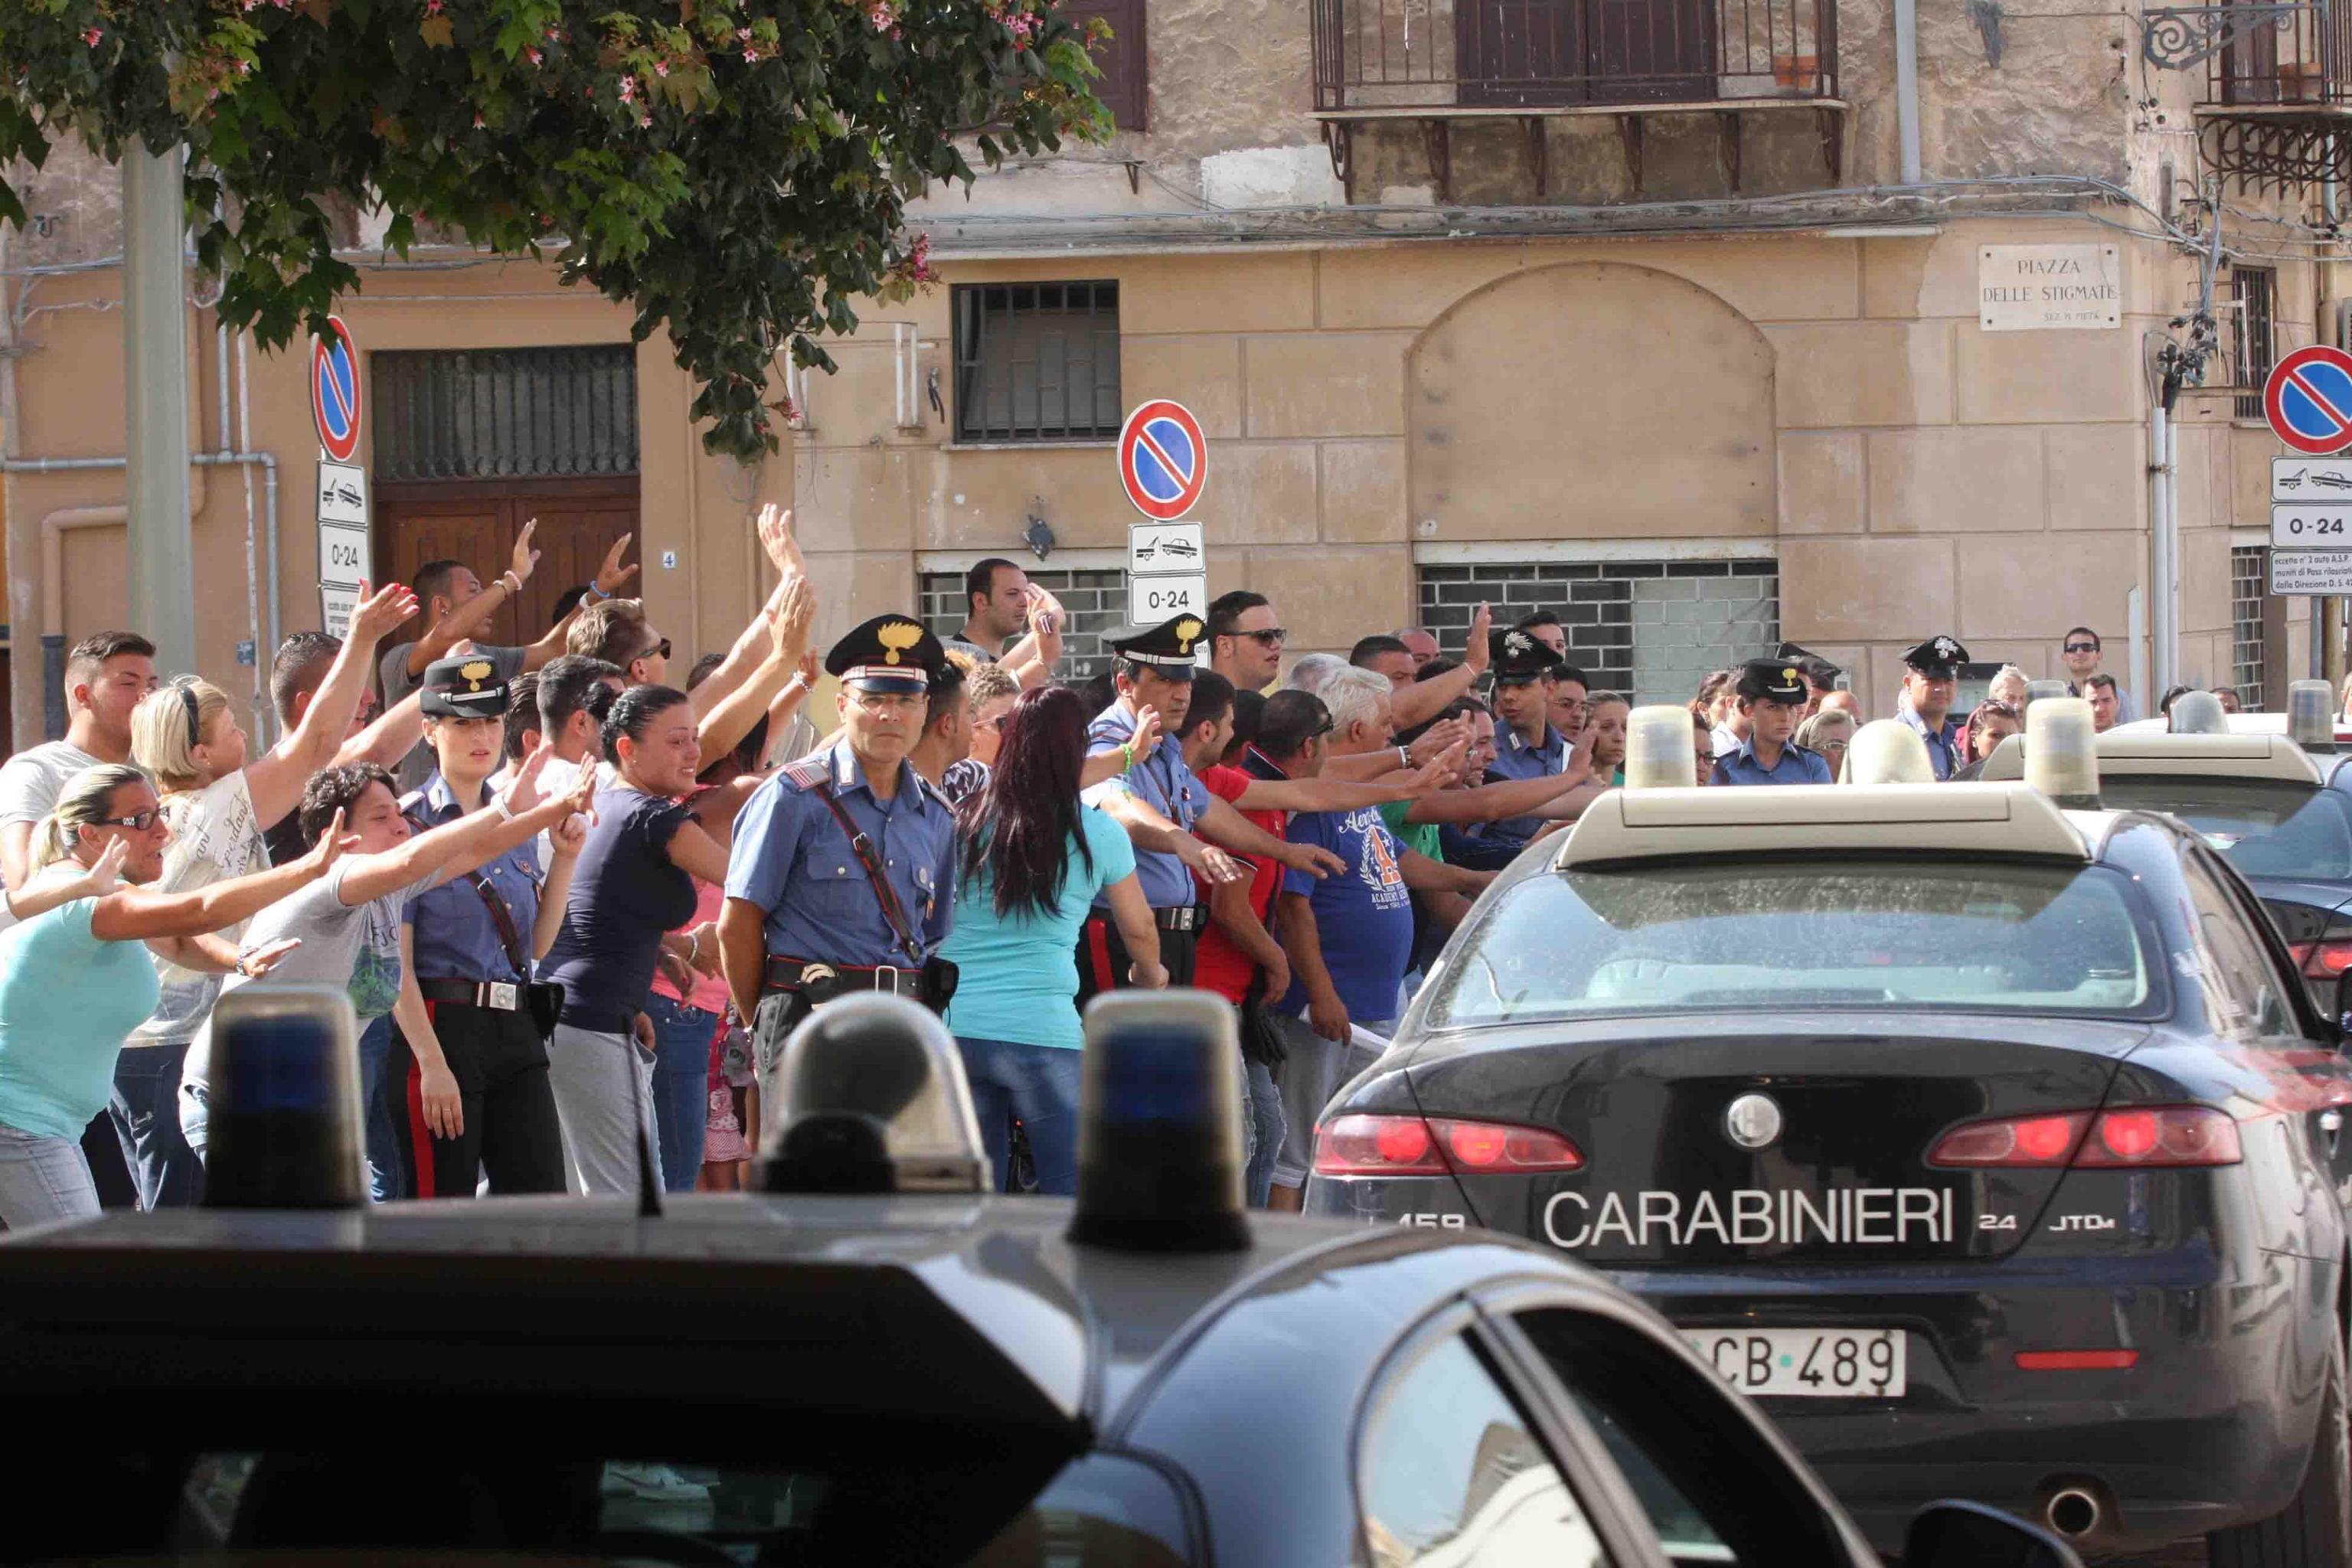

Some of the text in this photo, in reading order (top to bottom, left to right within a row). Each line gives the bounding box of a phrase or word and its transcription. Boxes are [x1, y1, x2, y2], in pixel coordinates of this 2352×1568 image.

[2018, 259, 2081, 274] PIAZZA
[1984, 284, 2117, 302] DELLE STIGMATE
[332, 544, 358, 567] 0-24
[664, 554, 673, 567] 4
[1148, 590, 1189, 609] 0-24
[1544, 1188, 1953, 1248] CARABINIERI
